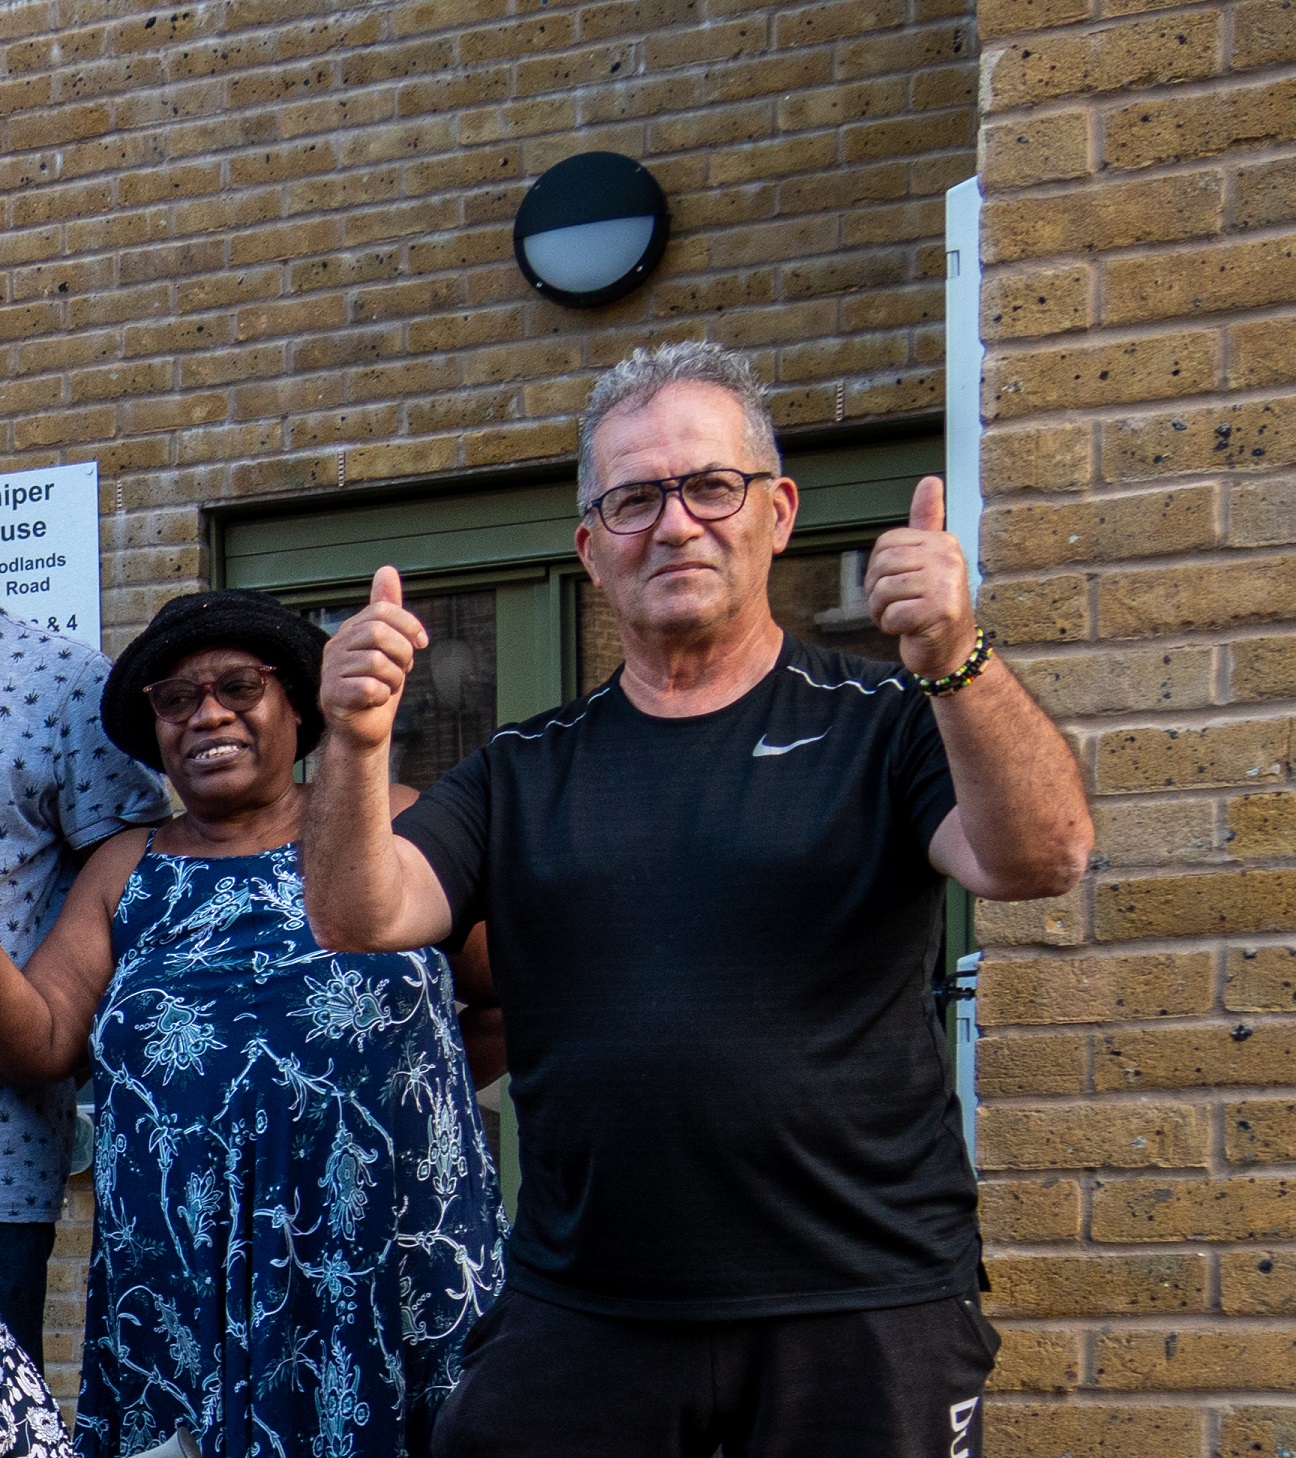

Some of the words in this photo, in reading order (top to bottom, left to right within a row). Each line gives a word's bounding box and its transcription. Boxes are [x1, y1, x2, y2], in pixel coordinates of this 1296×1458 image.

[6, 576, 51, 597] Road
[46, 616, 61, 633] &
[66, 613, 79, 631] 4
